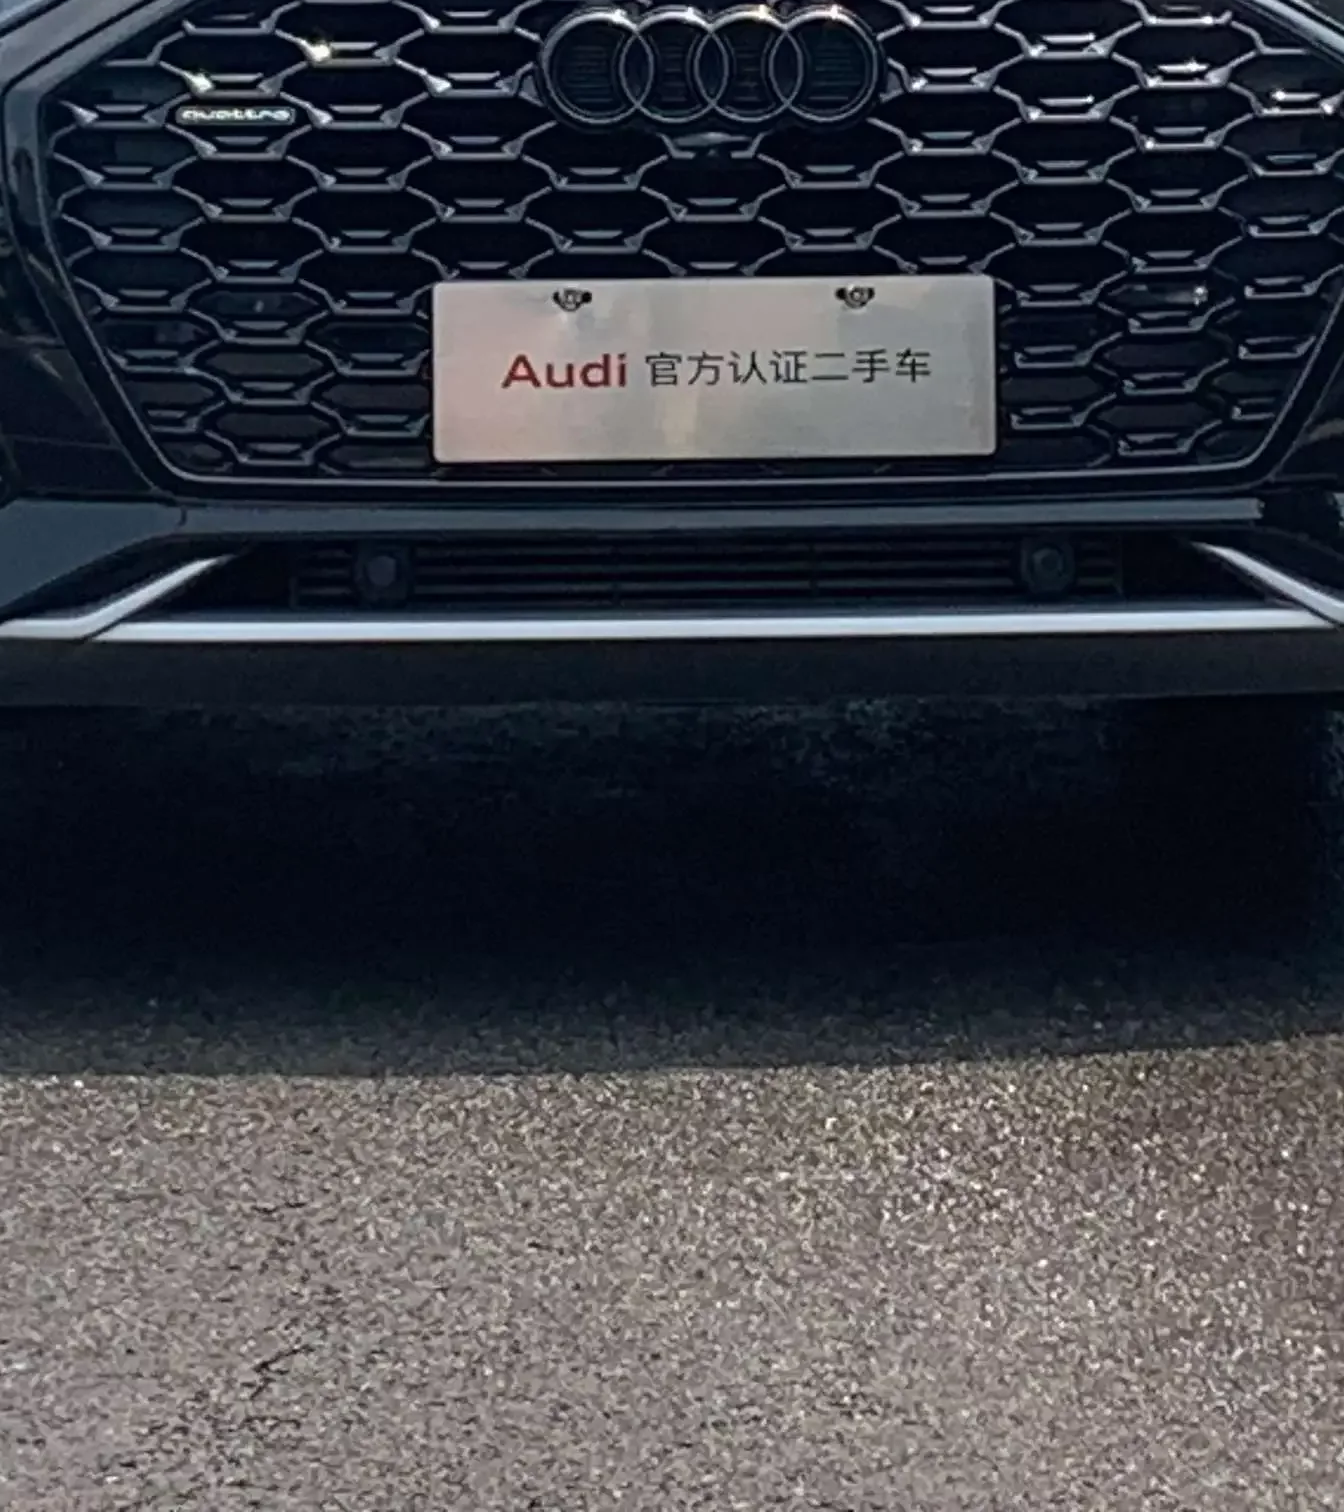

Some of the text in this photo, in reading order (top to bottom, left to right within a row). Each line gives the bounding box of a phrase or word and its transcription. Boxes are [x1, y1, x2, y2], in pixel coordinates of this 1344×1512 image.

[502, 347, 932, 389] Audi 官方认证二手车
